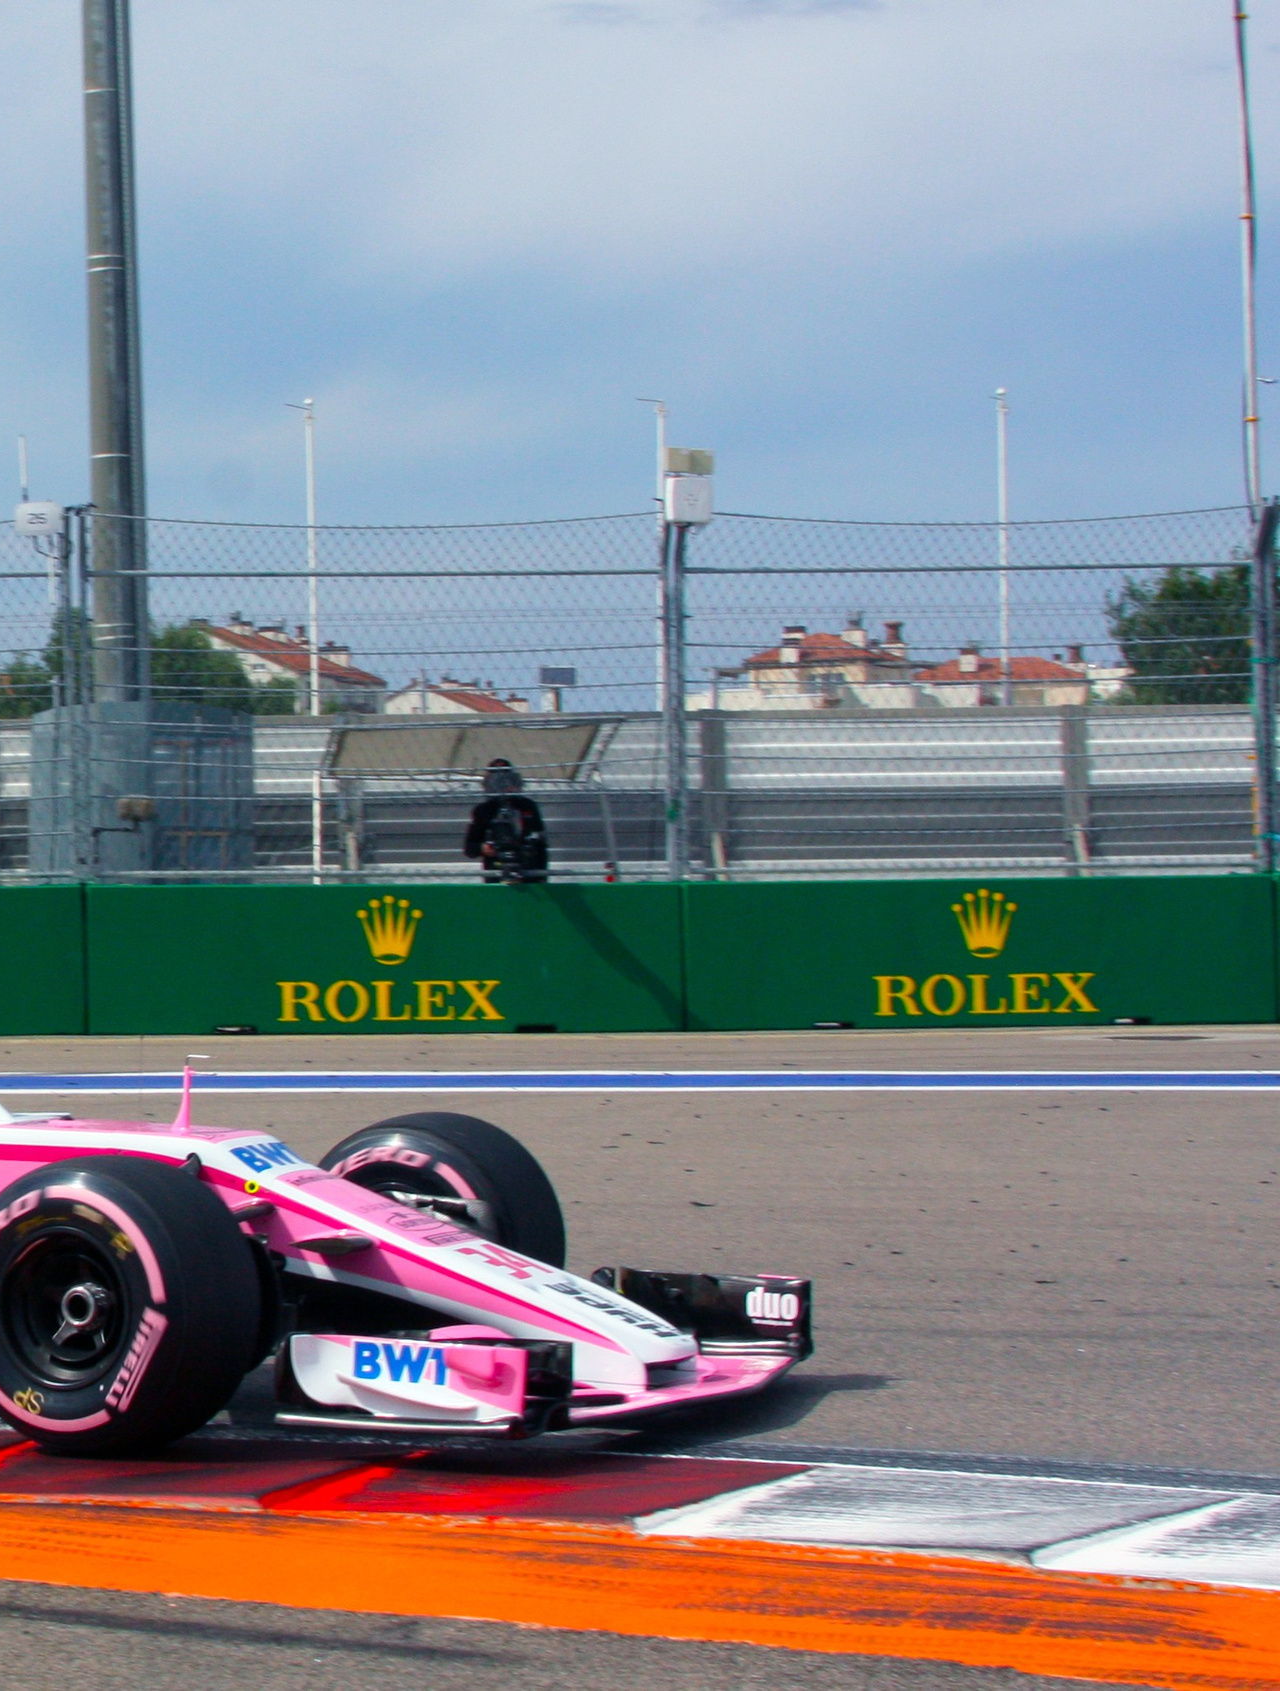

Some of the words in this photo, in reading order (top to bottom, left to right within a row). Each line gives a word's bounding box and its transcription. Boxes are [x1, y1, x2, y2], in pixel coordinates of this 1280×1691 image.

[277, 979, 505, 1023] ROLEX
[873, 972, 1100, 1016] ROLEX
[745, 1286, 799, 1320] duo
